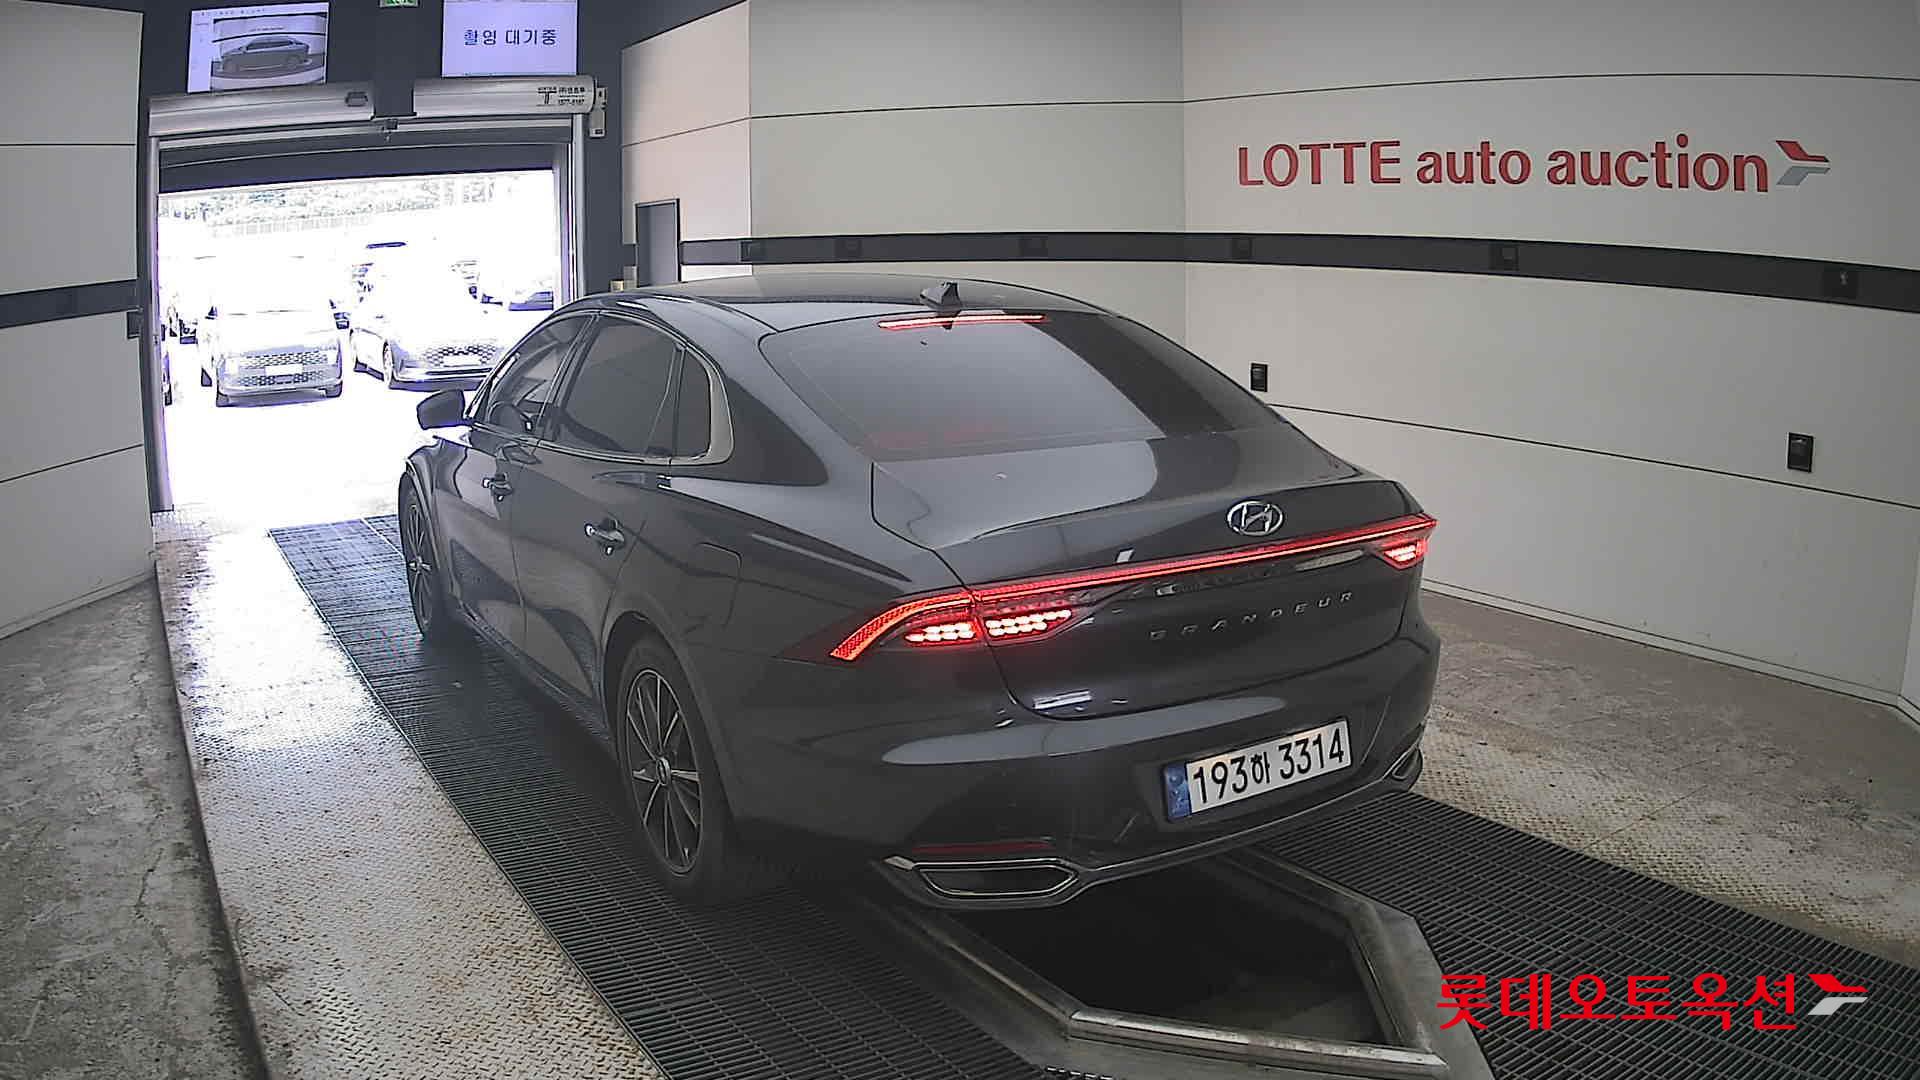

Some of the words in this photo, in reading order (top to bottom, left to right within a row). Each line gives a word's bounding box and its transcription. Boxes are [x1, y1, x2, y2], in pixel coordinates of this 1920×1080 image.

[505, 29, 557, 46] 대기중
[1240, 141, 1400, 187] LOTTE
[1417, 142, 1532, 185] auto
[1547, 135, 1768, 192] auction
[1150, 591, 1352, 640] GRANDEUR
[1192, 750, 1271, 804] 193하
[1278, 727, 1346, 780] 3314
